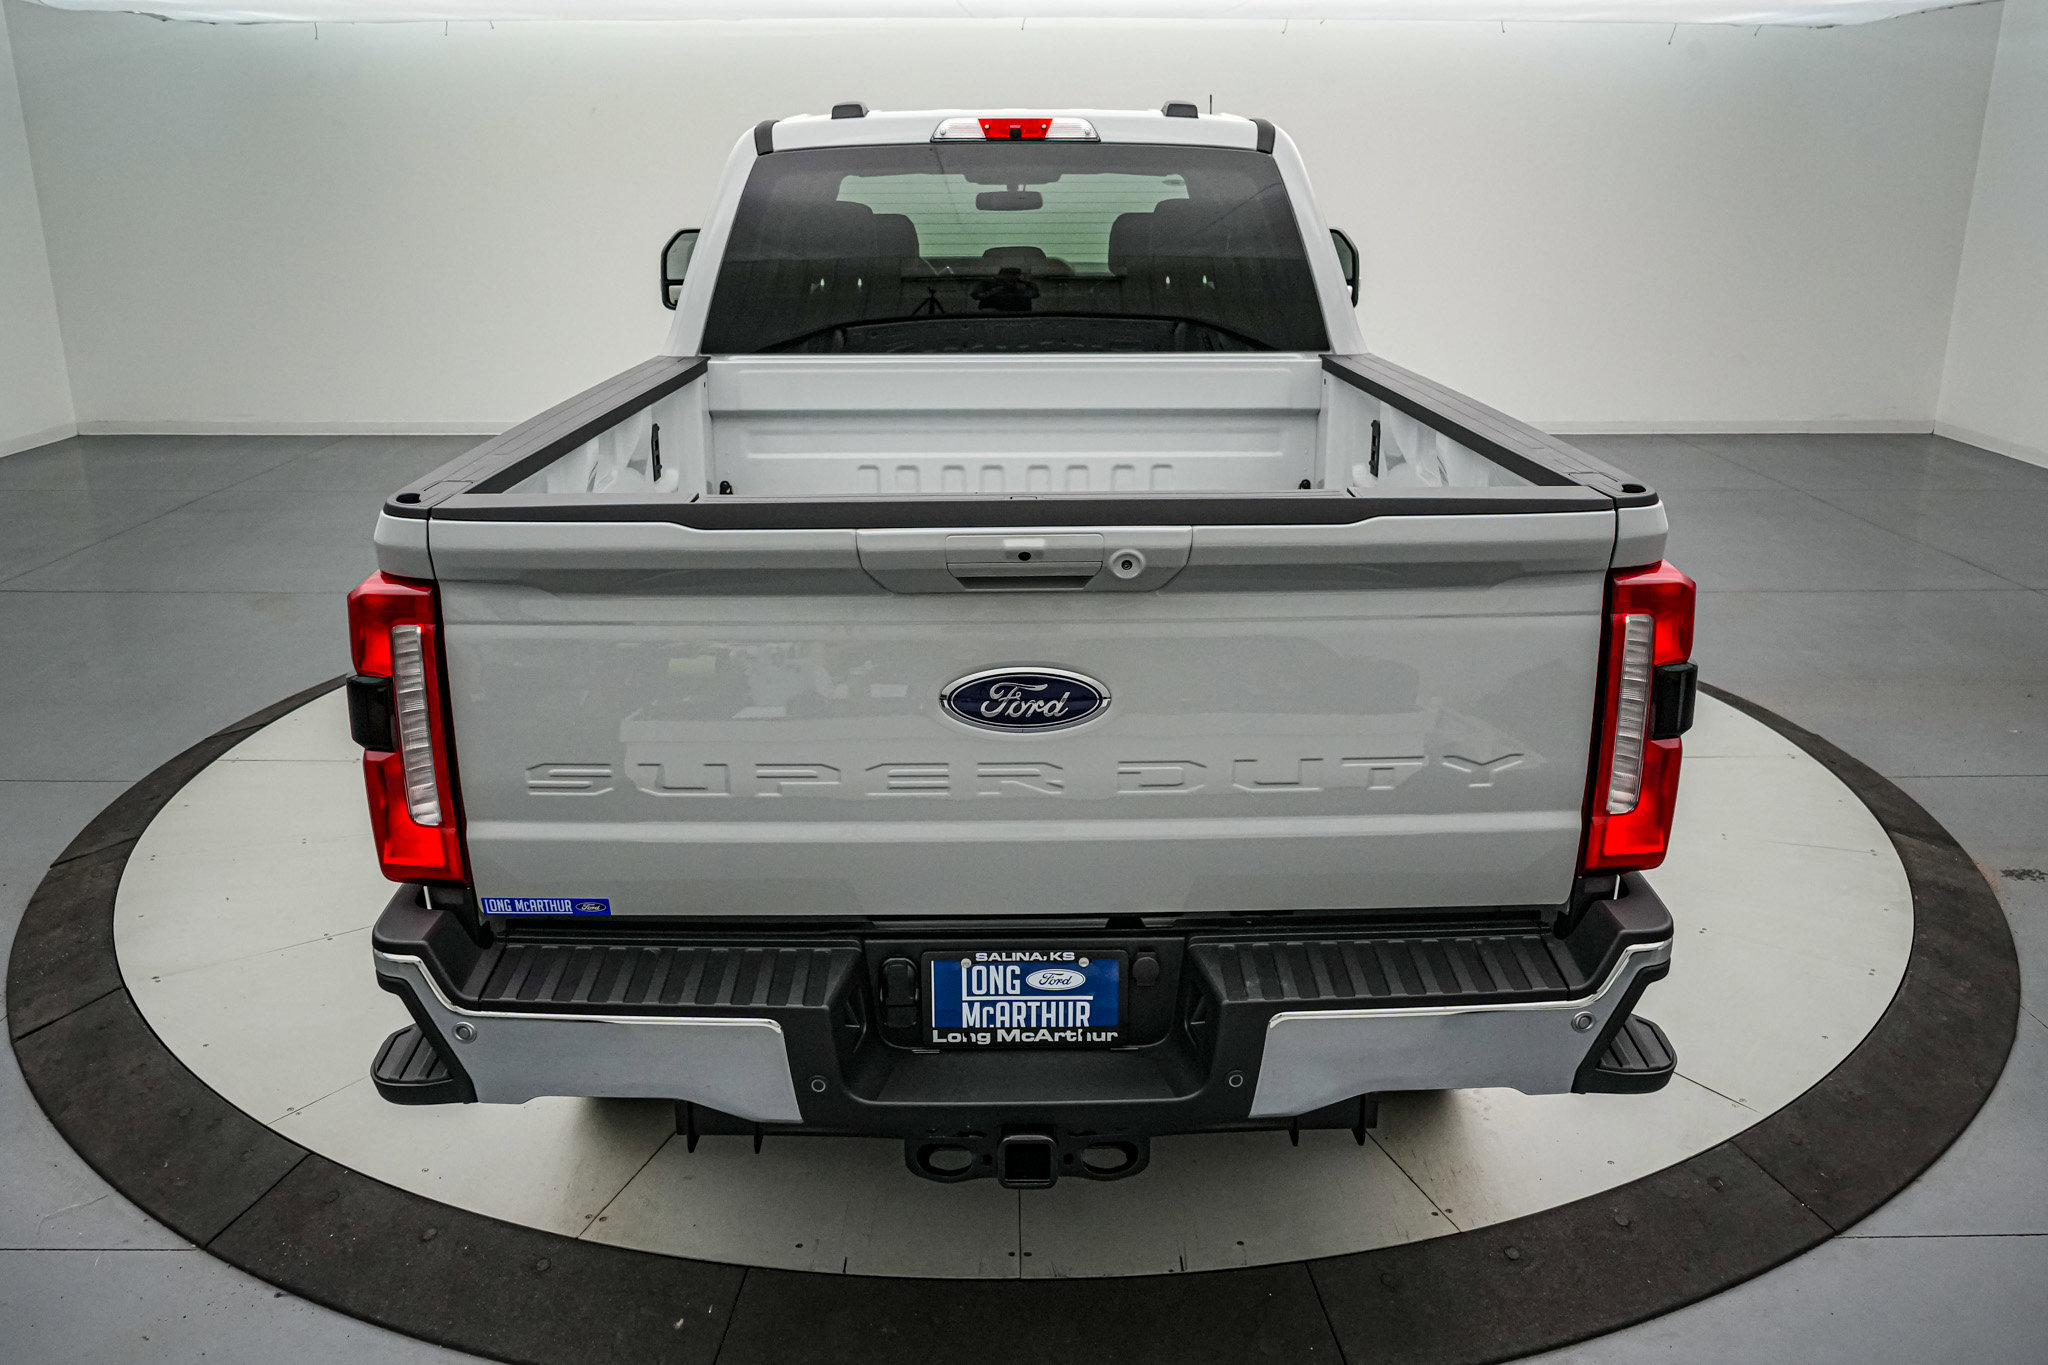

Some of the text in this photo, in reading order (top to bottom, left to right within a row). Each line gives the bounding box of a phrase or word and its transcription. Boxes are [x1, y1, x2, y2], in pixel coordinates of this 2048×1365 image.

[980, 682, 1071, 718] Ford
[526, 752, 1525, 797] SUPER DUTY
[484, 899, 512, 913] LONG
[514, 899, 573, 912] McARTHUR
[1049, 952, 1075, 961] KS
[961, 965, 1073, 1001] LONG Ford
